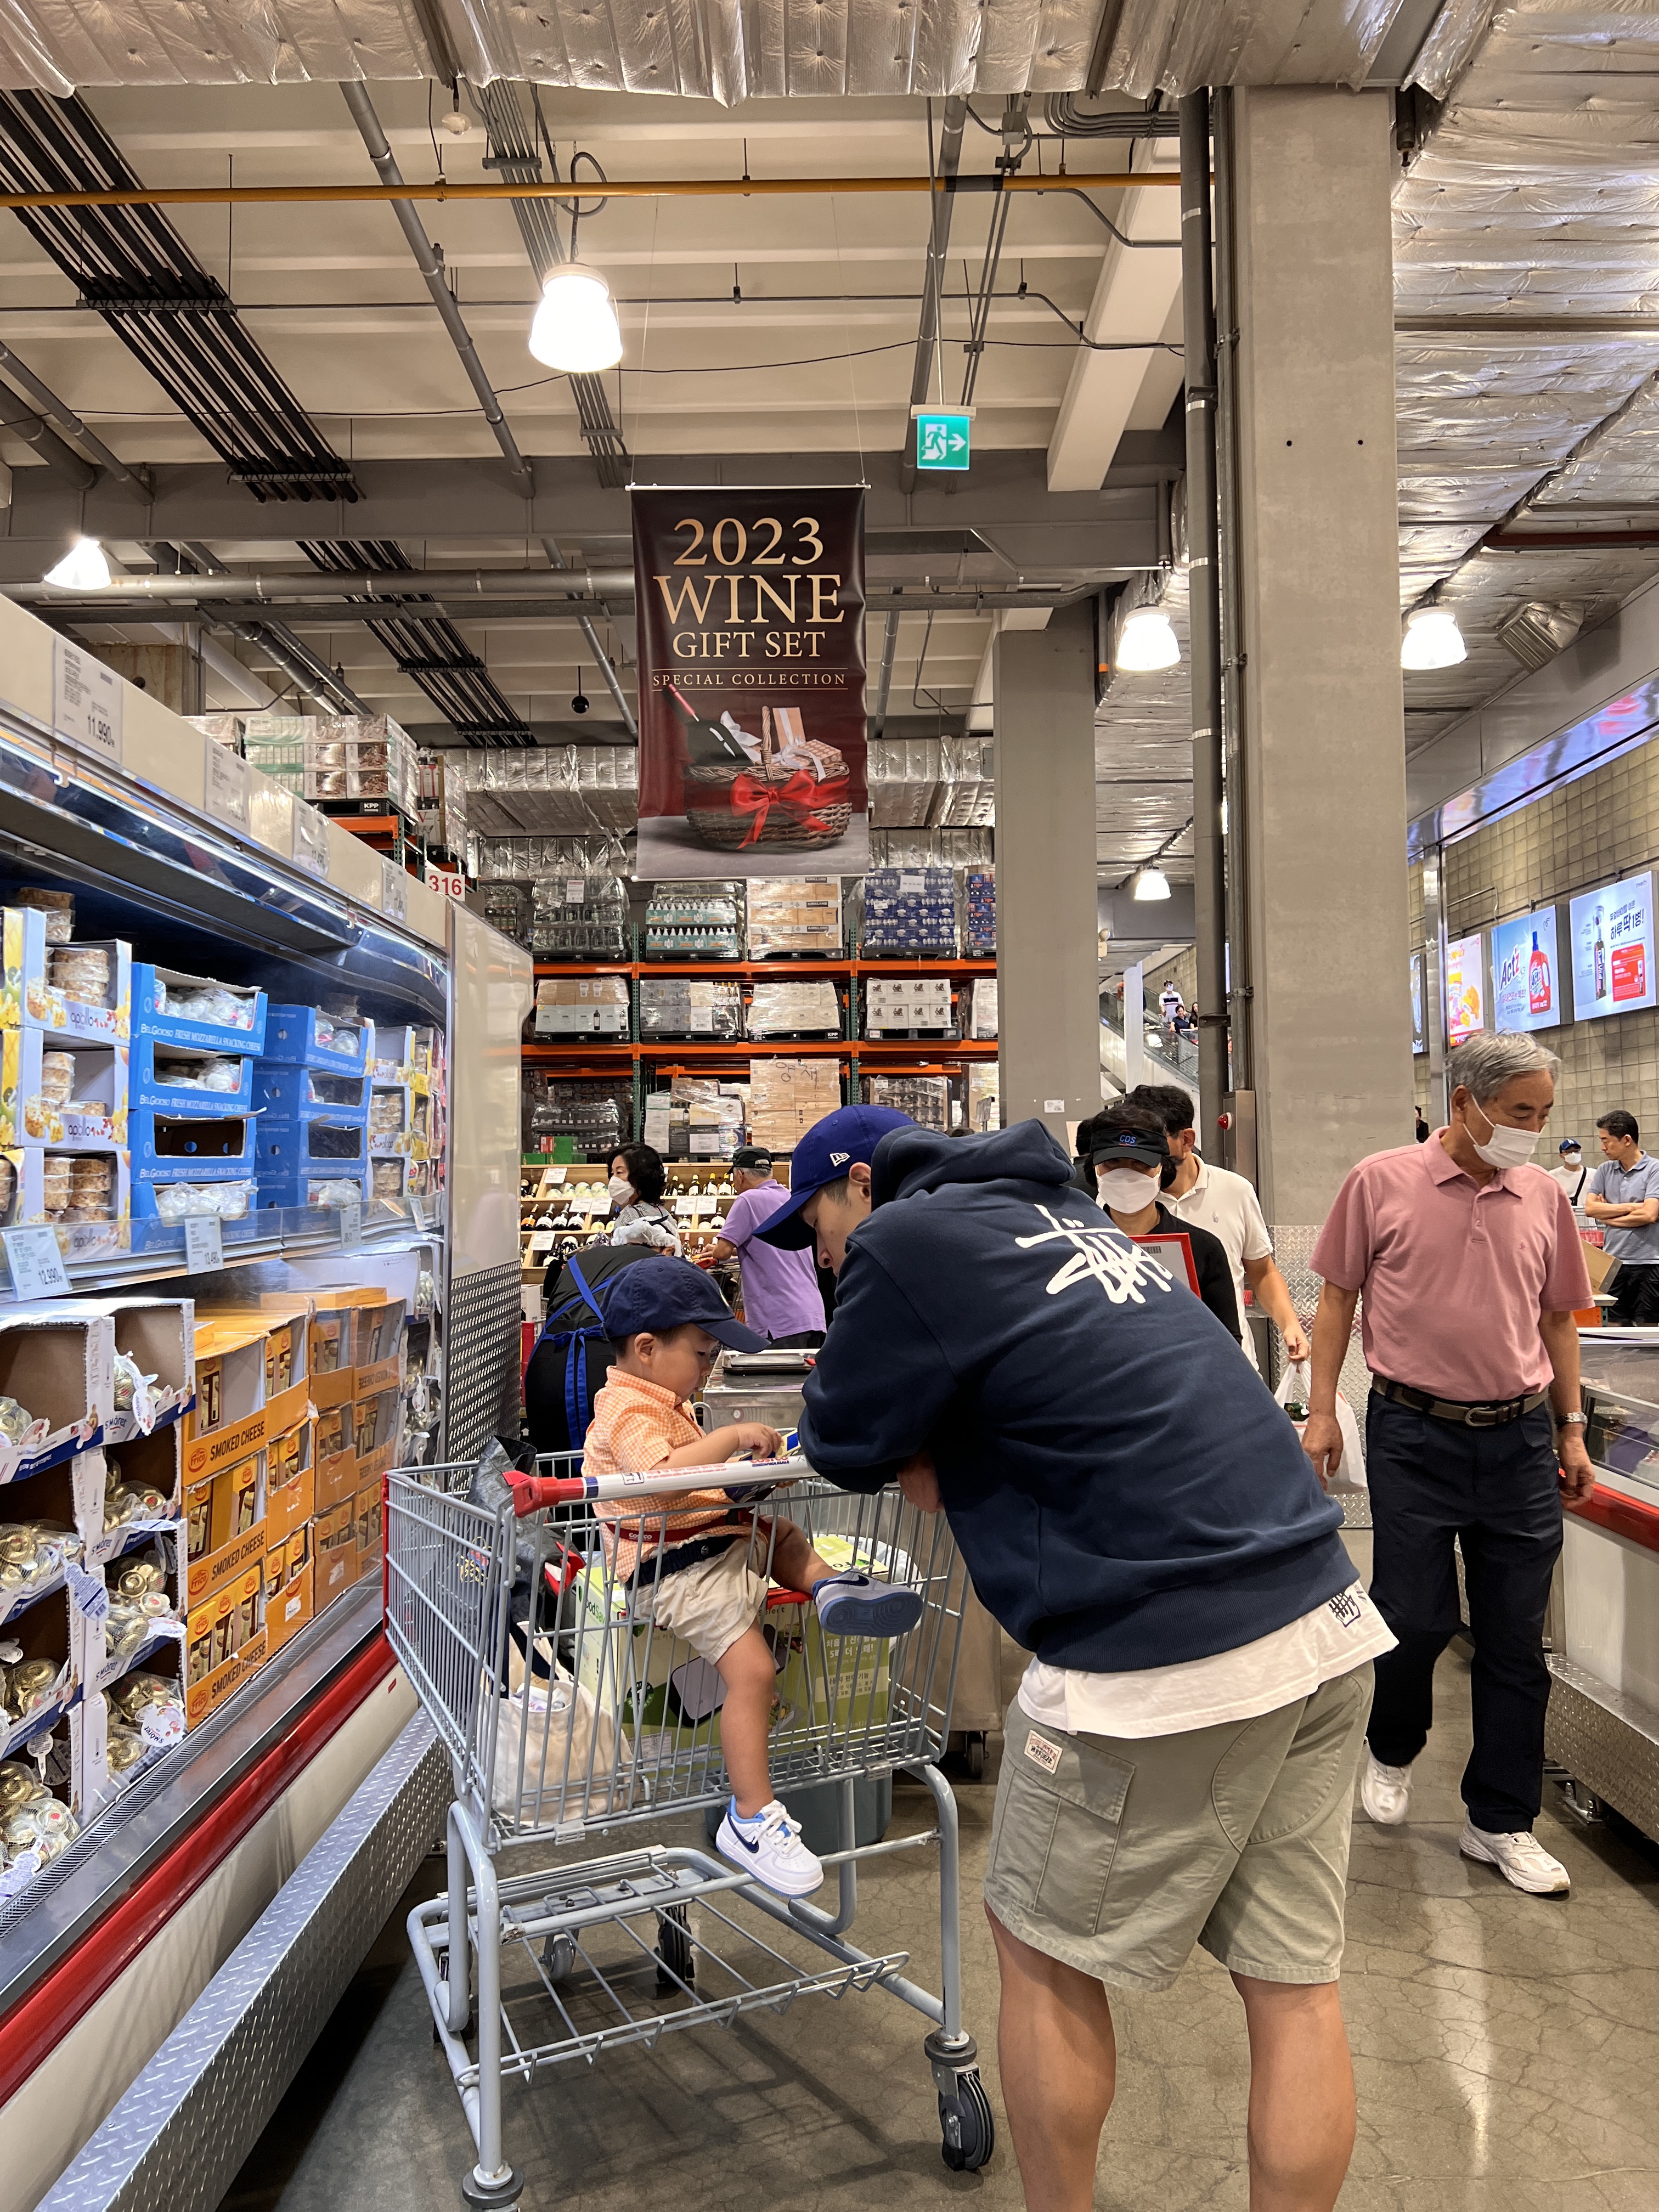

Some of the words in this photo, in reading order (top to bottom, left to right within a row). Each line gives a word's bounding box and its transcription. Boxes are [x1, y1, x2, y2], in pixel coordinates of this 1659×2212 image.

[674, 517, 824, 566] 2023
[653, 574, 845, 624] WINE
[673, 631, 755, 658] GIFT
[765, 631, 826, 658] SET
[652, 673, 724, 686] SPECIAL
[732, 673, 846, 686] COLLECTION
[429, 875, 462, 896] 316
[1119, 1134, 1136, 1144] CDS
[190, 1454, 205, 1468] Frico
[210, 1434, 240, 1461] SMOKED
[241, 1420, 265, 1446] CHEESE
[191, 1576, 206, 1590] Frico
[211, 1549, 240, 1581] SMOKED
[241, 1530, 265, 1560] CHEESE
[211, 1662, 241, 1699] SMOKED
[241, 1639, 266, 1673] CHEESE
